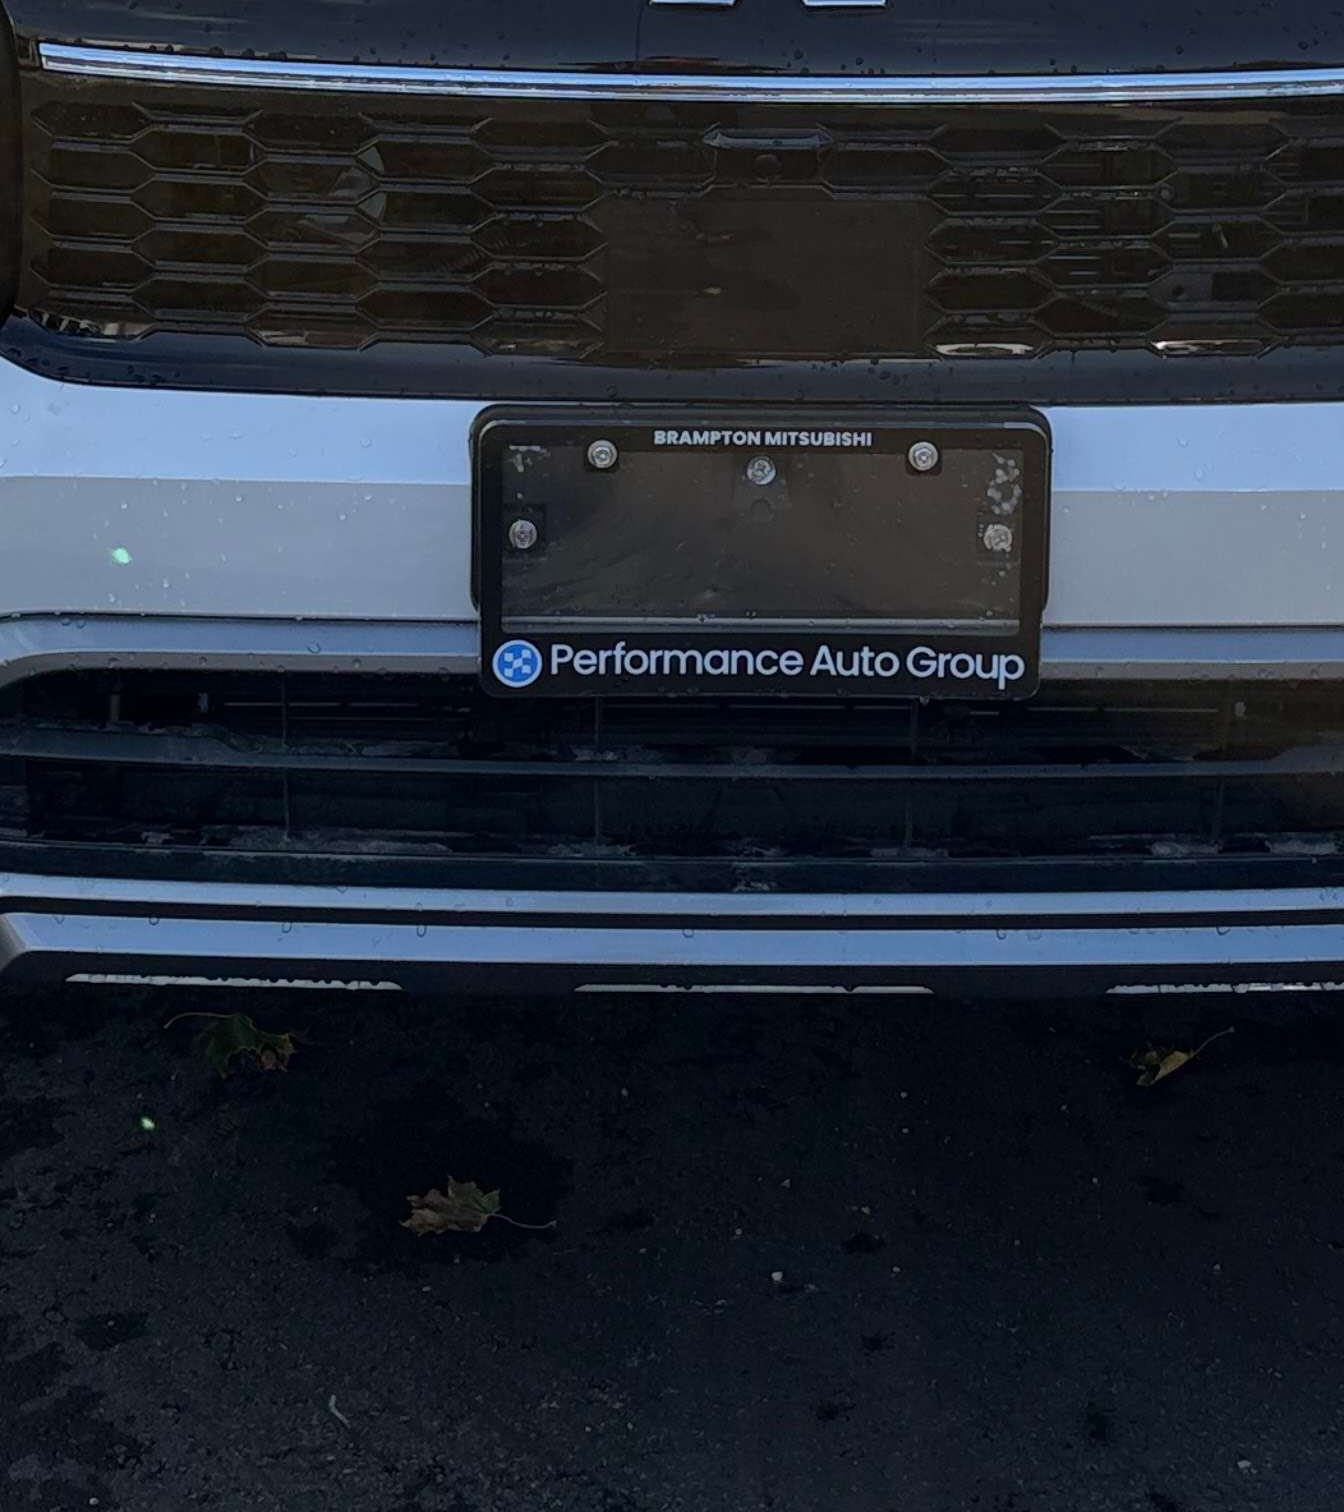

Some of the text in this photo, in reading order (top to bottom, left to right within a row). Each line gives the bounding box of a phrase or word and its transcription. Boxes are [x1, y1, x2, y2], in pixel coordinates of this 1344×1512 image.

[654, 430, 873, 448] BRAMPTON MITSUBISHI
[551, 641, 1025, 690] Performance Auto Group
